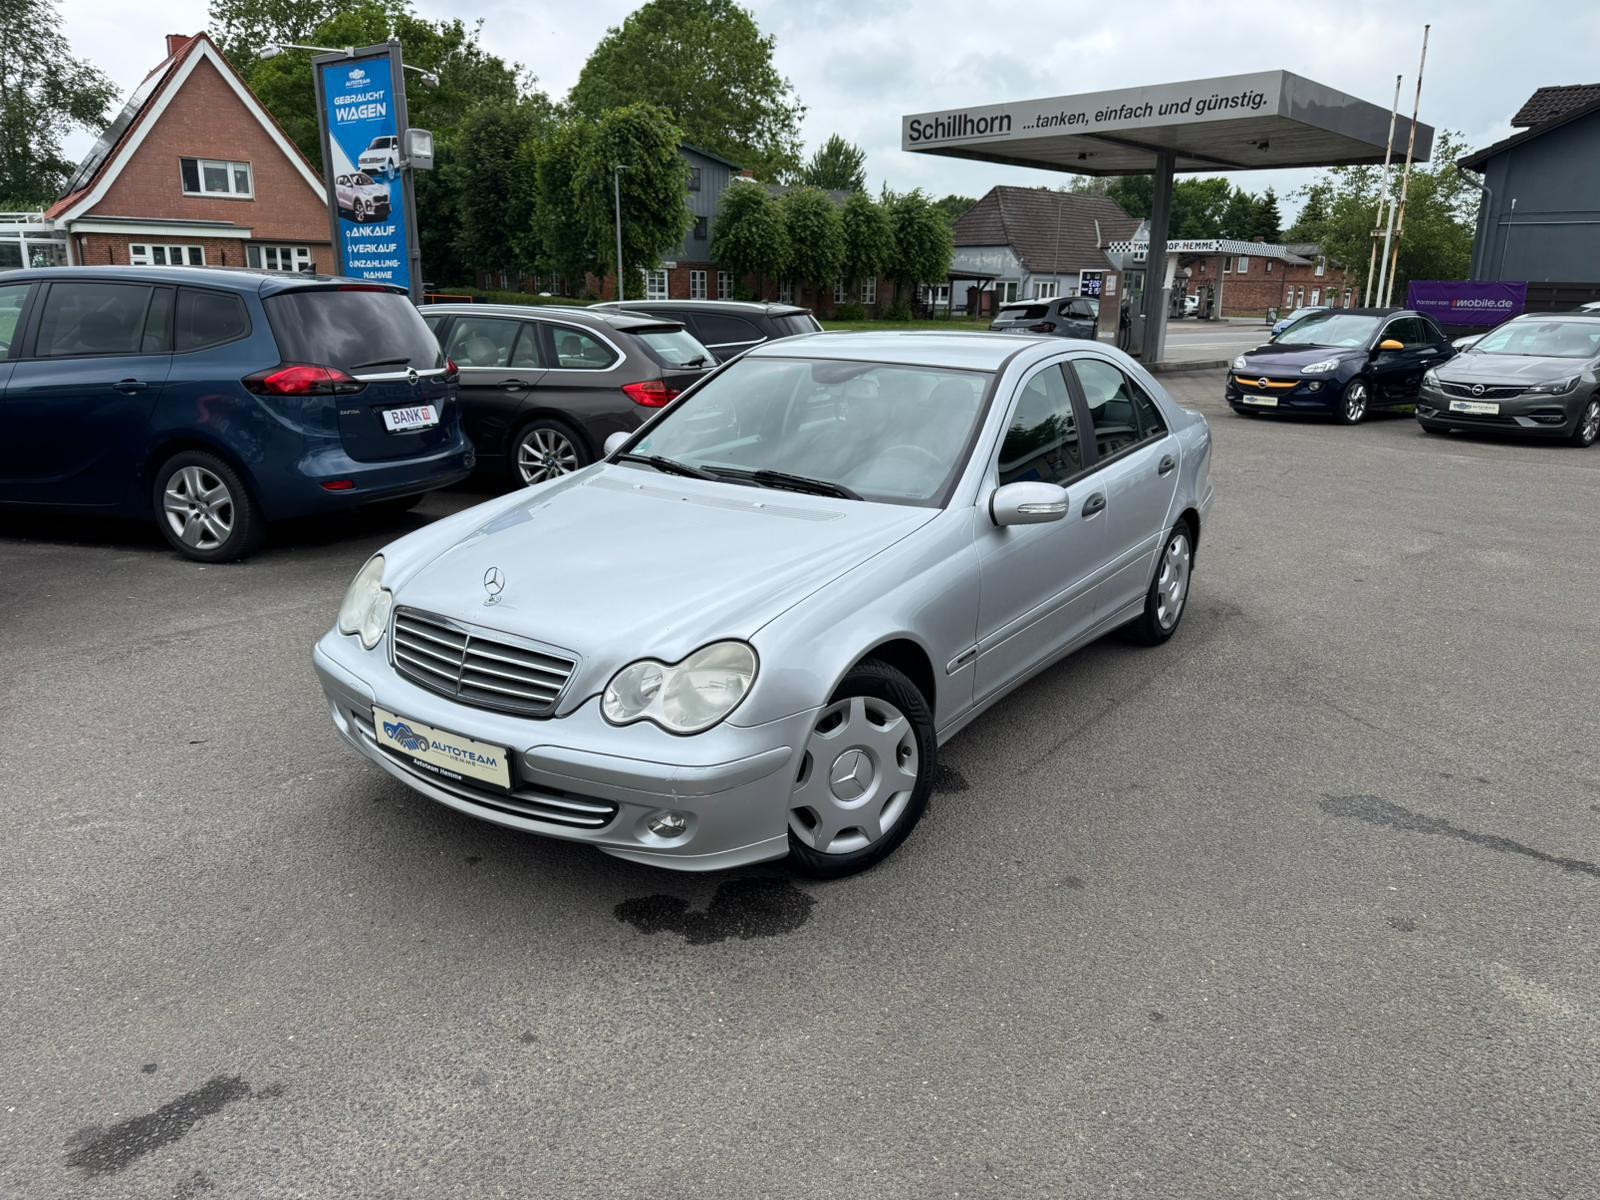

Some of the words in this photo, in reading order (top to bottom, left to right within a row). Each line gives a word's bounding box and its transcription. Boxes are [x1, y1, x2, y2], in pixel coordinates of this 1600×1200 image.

[334, 90, 384, 105] GEBRAUCHT
[336, 102, 386, 122] WAGEN
[909, 113, 1011, 141] Schillhorn
[1094, 102, 1153, 122] einfach
[1158, 97, 1192, 116] und
[1194, 90, 1267, 115] günstig.
[351, 225, 396, 236] ANKAUF
[352, 243, 397, 252] VERKAUF
[353, 259, 401, 268] INZAHLUNG-
[391, 409, 422, 424] BANK
[431, 741, 498, 767] AUTOTEAM
[450, 755, 477, 767] HEMME
[413, 758, 439, 773] Autoteam
[440, 767, 462, 780] Hemme
